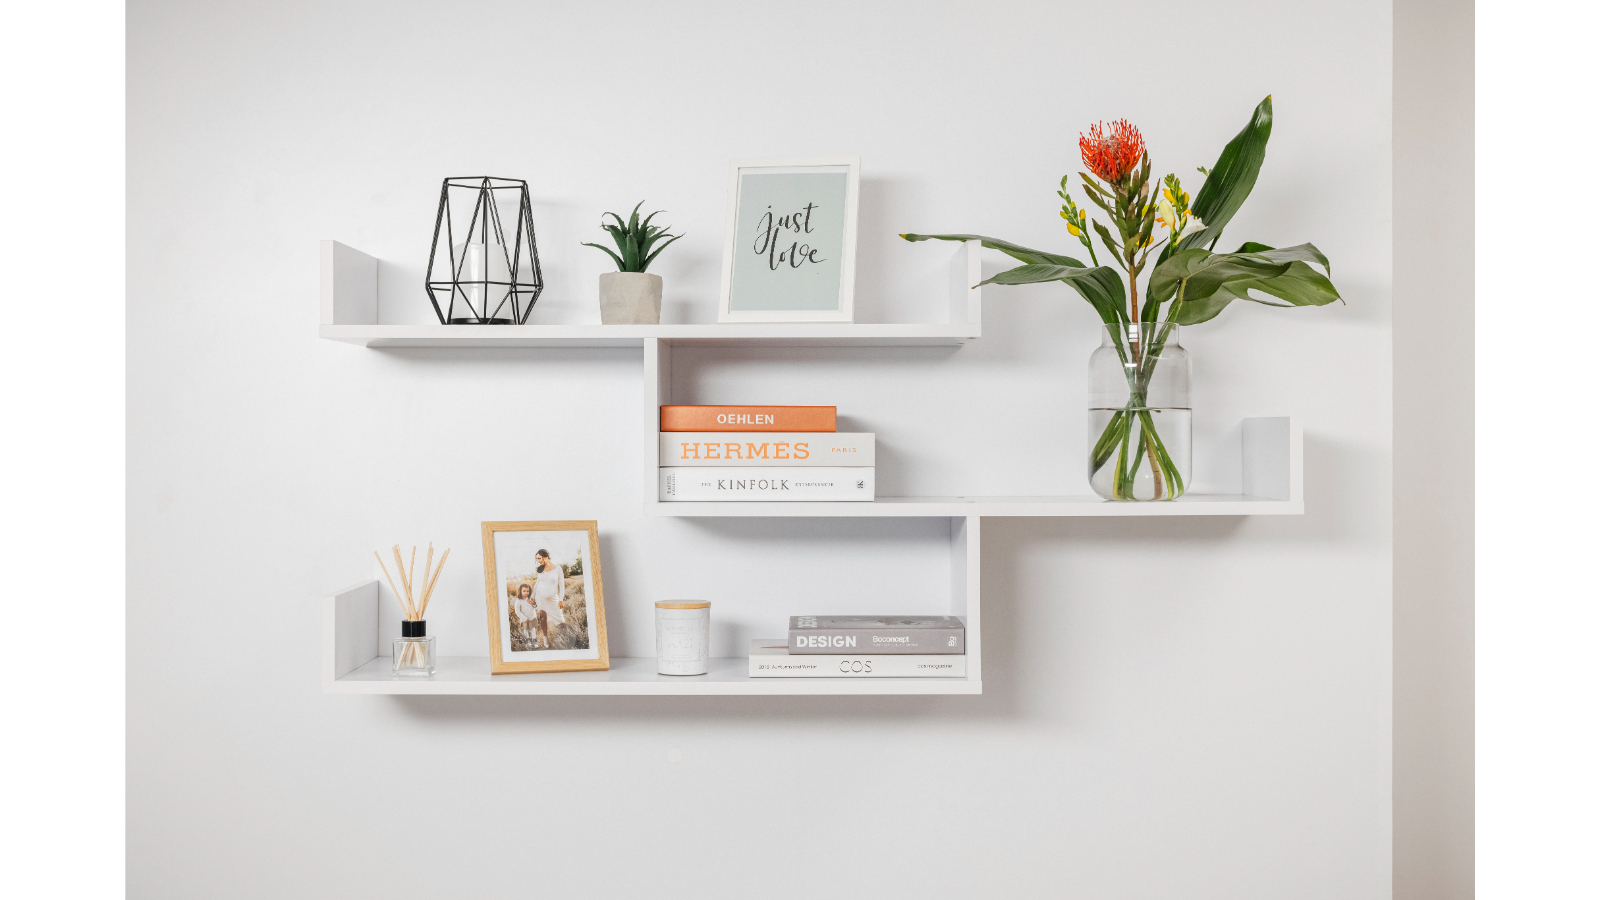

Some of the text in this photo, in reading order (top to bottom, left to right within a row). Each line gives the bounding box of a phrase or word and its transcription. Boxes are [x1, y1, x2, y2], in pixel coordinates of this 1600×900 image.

[754, 202, 819, 255] just
[769, 227, 827, 271] love
[717, 414, 774, 424] OEHLEN
[718, 480, 789, 490] KINFOLK
[796, 636, 856, 647] DESIGN
[839, 661, 872, 673] COS
